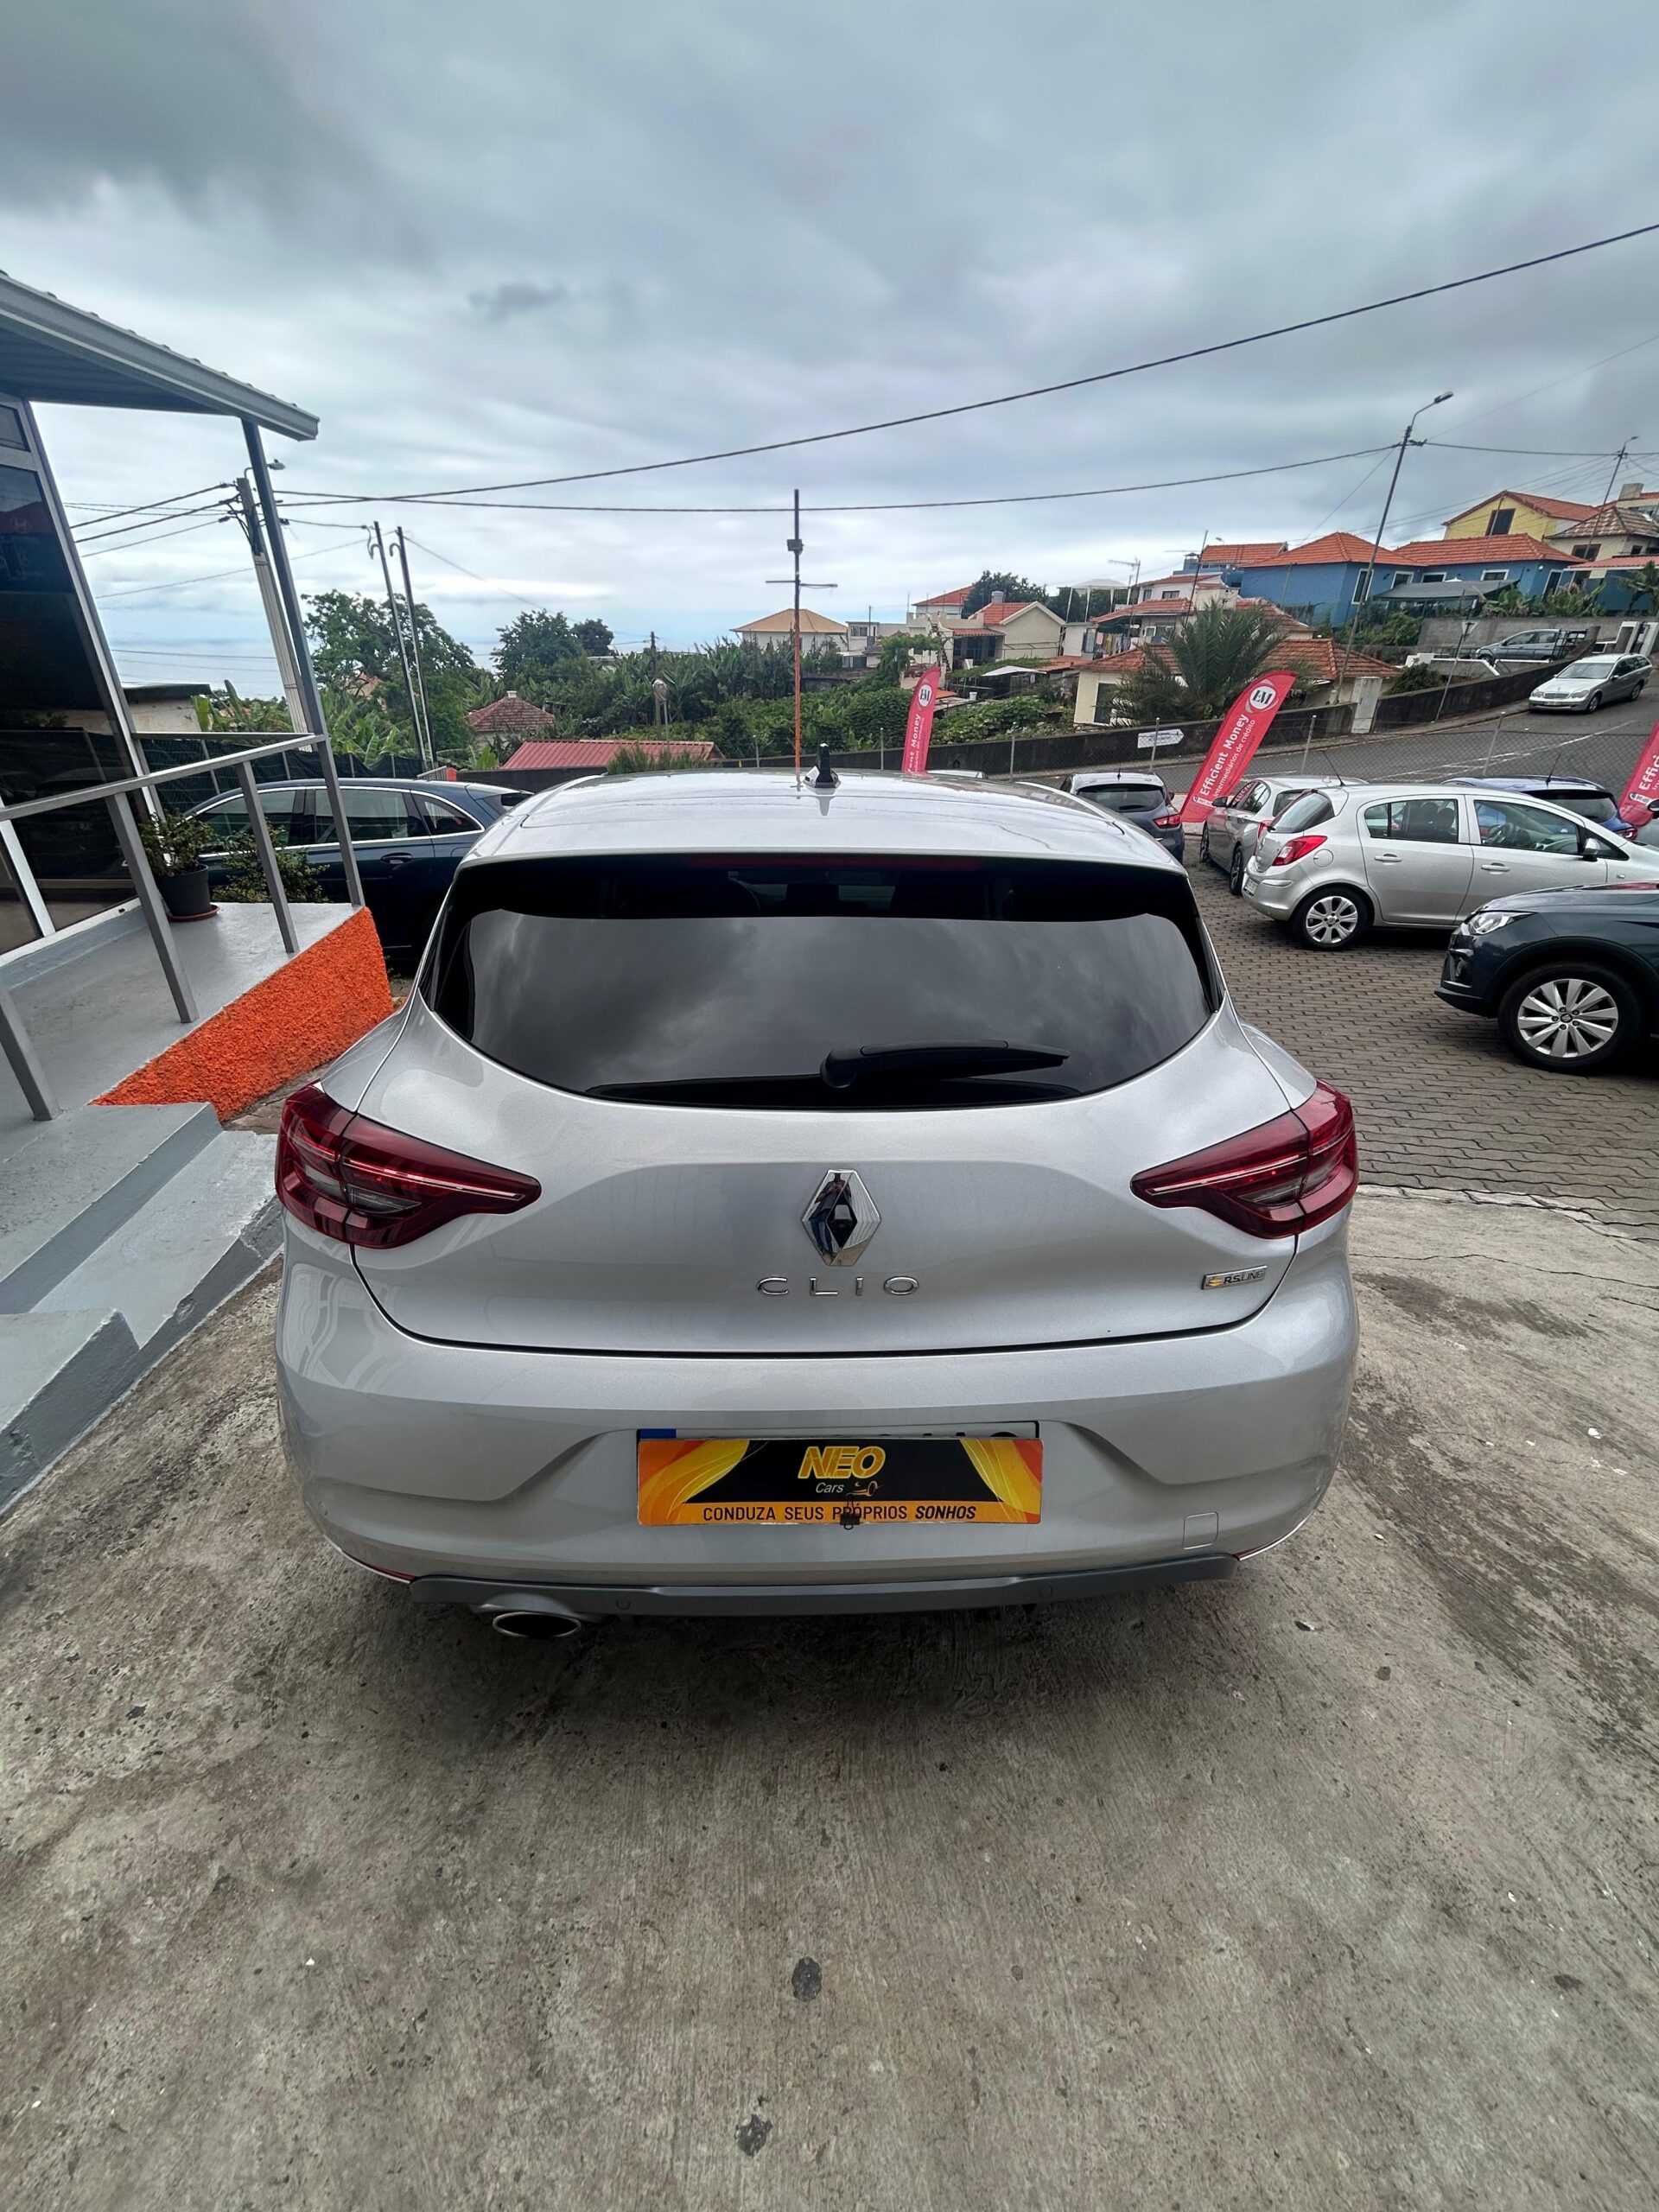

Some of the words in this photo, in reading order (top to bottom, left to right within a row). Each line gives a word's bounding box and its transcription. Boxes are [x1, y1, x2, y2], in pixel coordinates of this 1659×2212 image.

[911, 714, 922, 747] Money
[1241, 719, 1255, 743] crédito
[1199, 752, 1229, 796] Efficient
[1223, 714, 1249, 749] Money
[756, 1276, 919, 1297] CLIO
[798, 1446, 886, 1478] NEO
[816, 1482, 845, 1493] Cars
[703, 1505, 776, 1521] CONDUZA
[785, 1506, 823, 1520] SEUS
[915, 1504, 976, 1520] SONHOS
